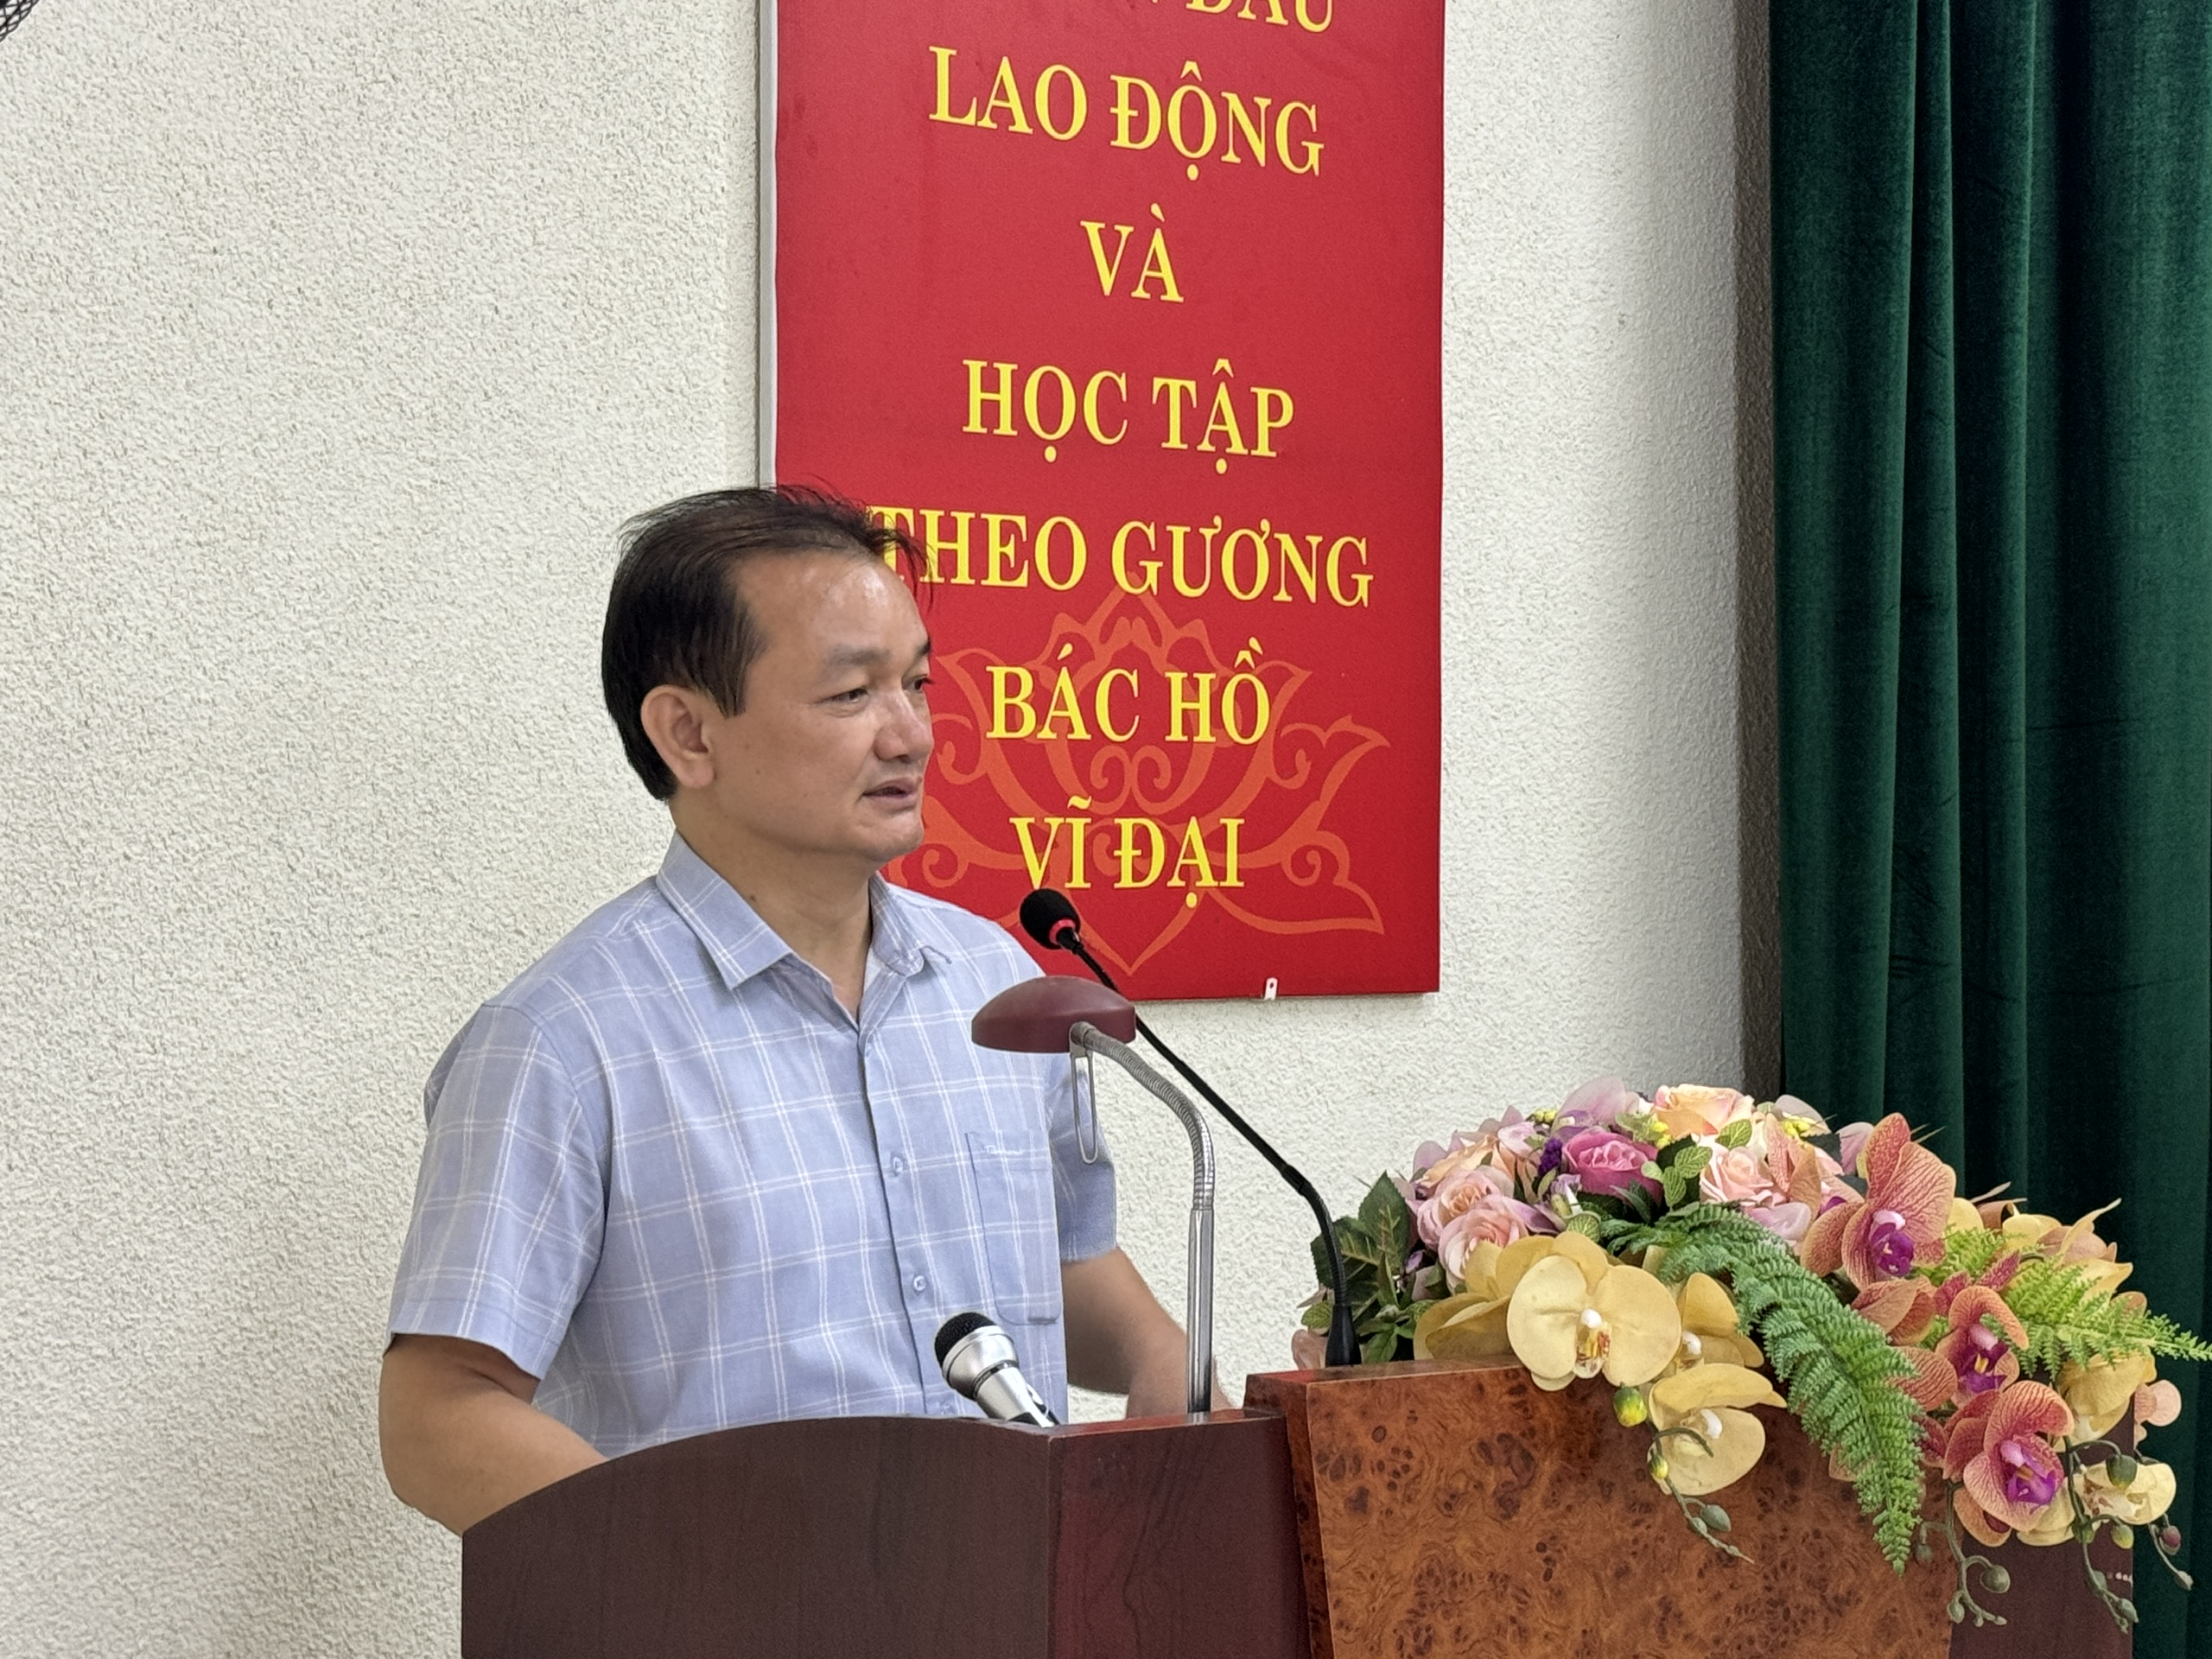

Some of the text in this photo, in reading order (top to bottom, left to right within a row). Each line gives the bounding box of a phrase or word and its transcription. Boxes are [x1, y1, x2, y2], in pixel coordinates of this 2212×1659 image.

[929, 46, 1325, 180] LAO ĐỘNG
[1081, 203, 1184, 302] VÀ
[963, 359, 1294, 474] HỌC TẬP
[866, 505, 1374, 607] THEO GƯƠNG
[986, 637, 1270, 745] BÁC HỒ
[1009, 795, 1245, 908] VĨ ĐẠI
